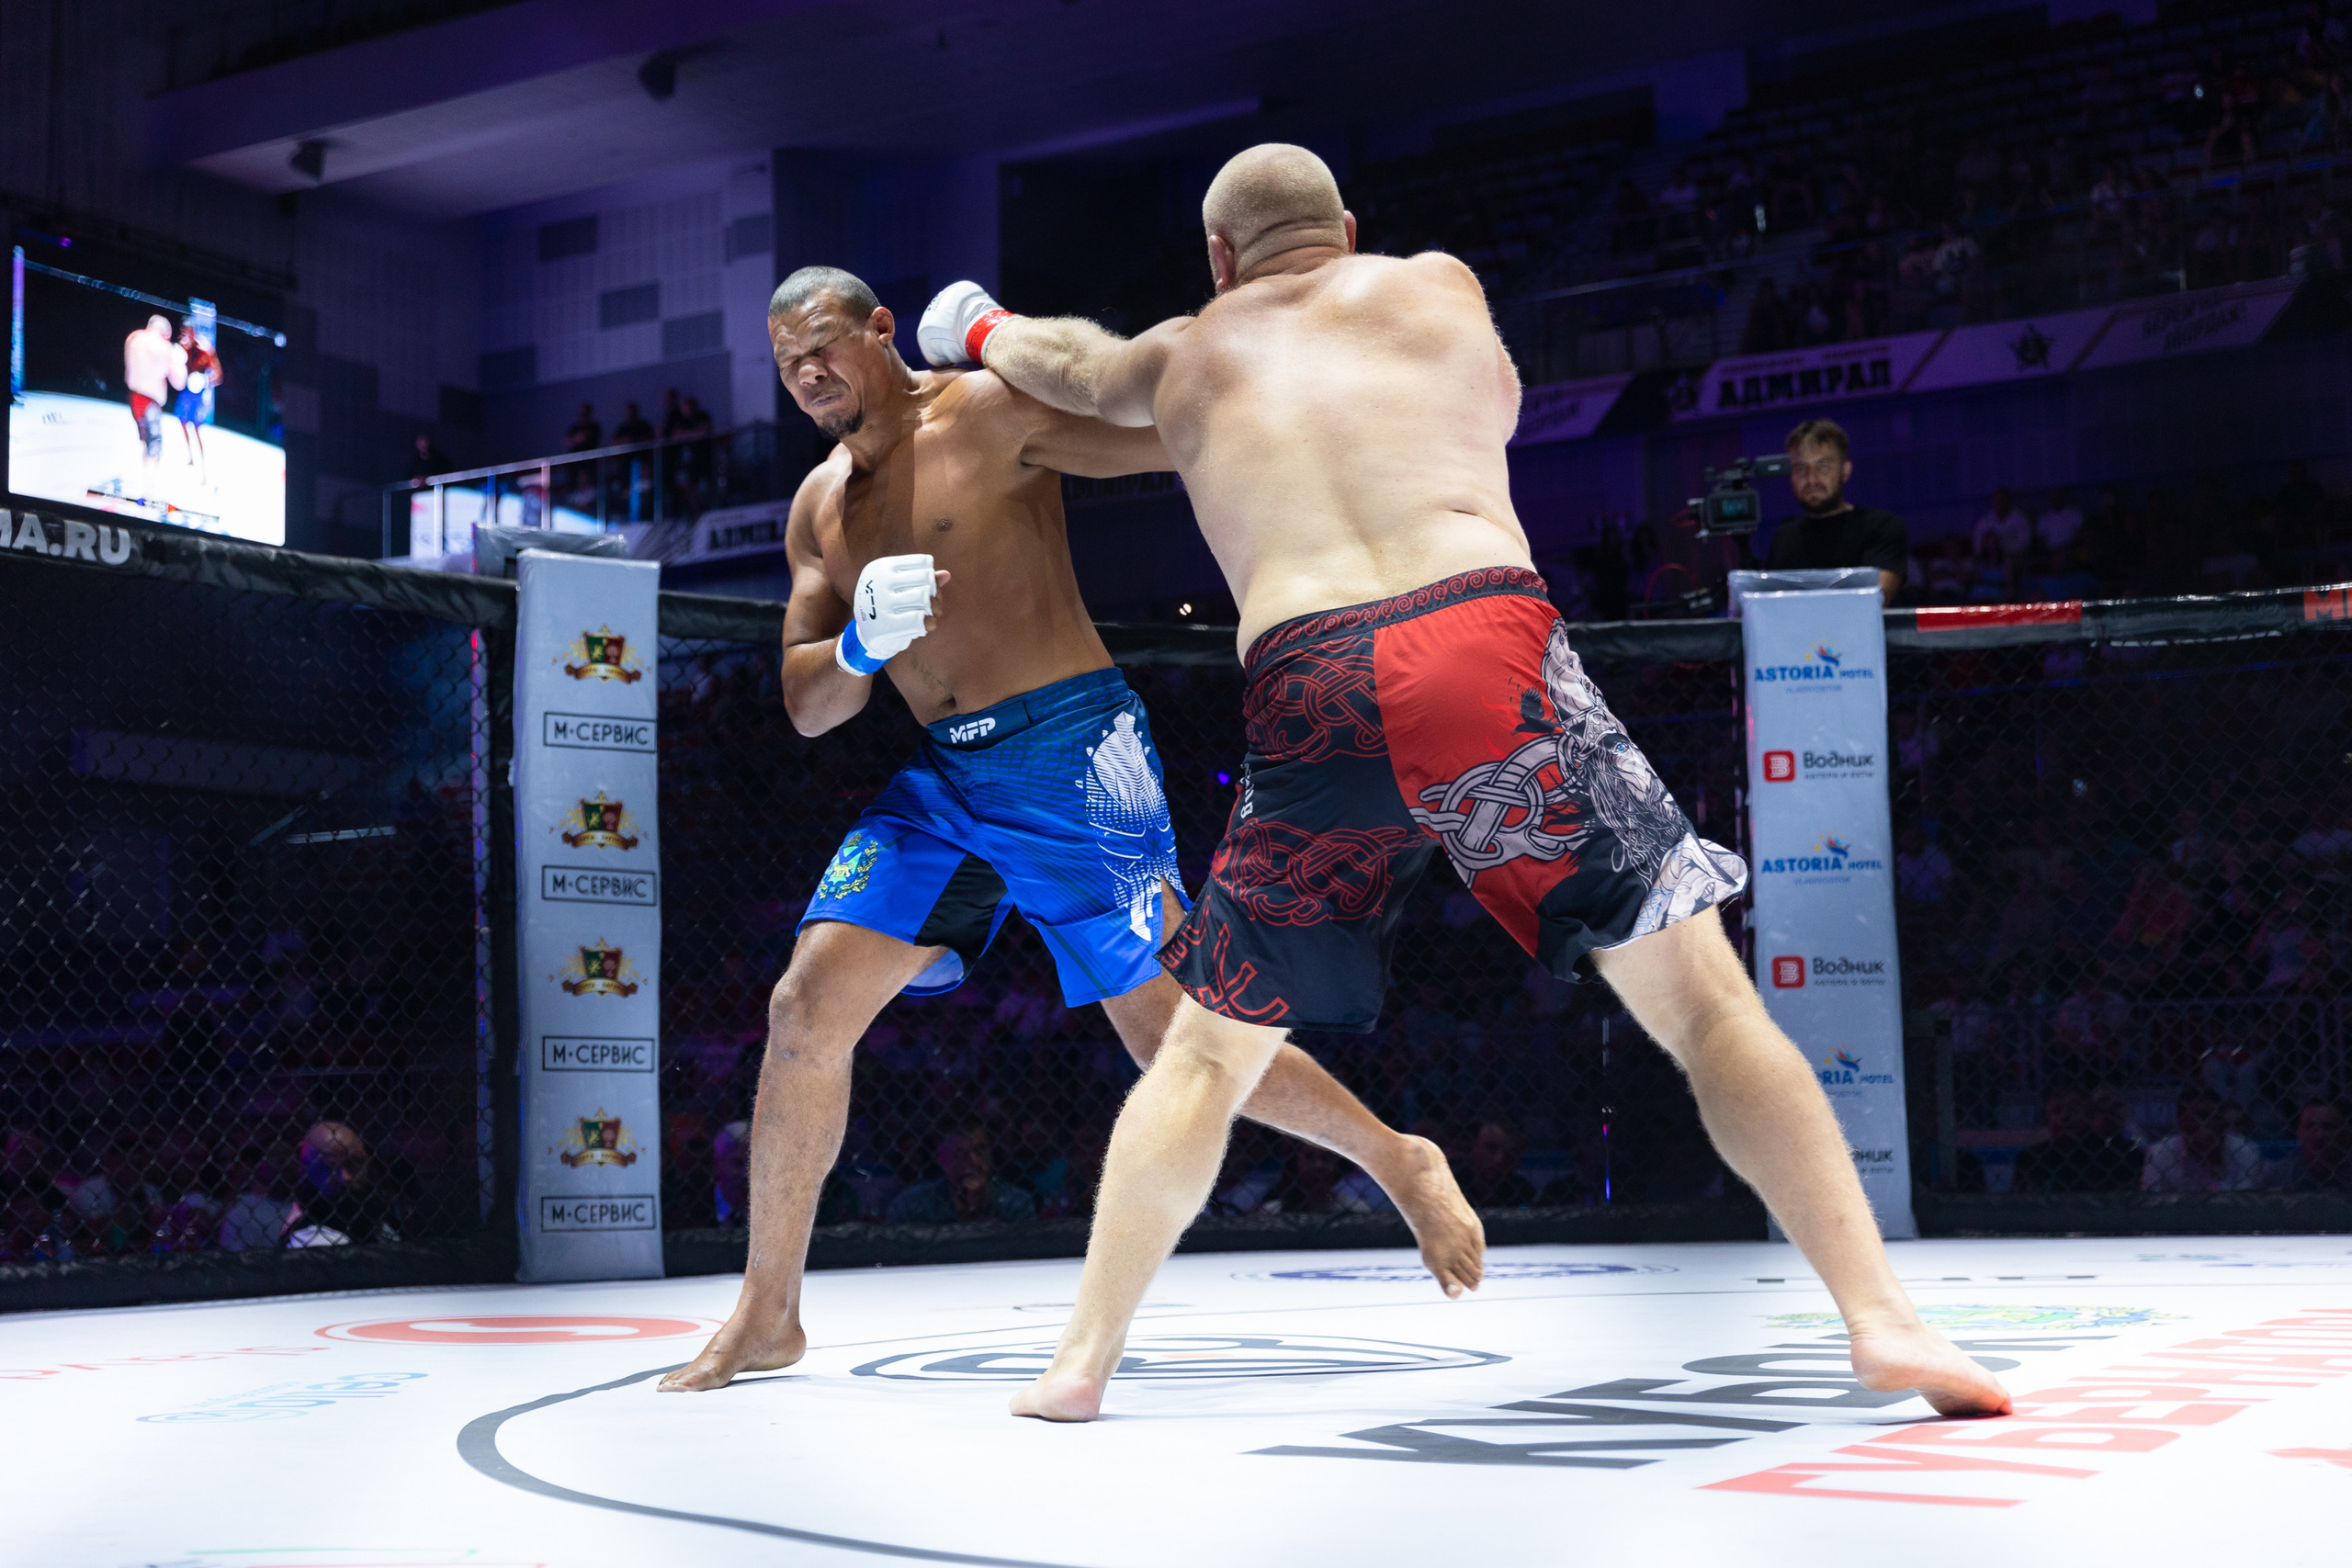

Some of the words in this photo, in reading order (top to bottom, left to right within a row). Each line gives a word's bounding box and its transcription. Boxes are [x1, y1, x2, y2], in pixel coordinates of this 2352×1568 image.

[1718, 358, 1891, 408] АДМИРАЛ
[2303, 589, 2352, 622] M
[1755, 664, 1834, 682] ASTORIA
[1839, 668, 1874, 680] HOTEL
[949, 717, 997, 745] MFP
[1804, 750, 1874, 769] Водник
[1761, 856, 1843, 874] ASTORIA
[1848, 859, 1883, 871] HOTEL
[1813, 956, 1884, 976] Водник
[1819, 1069, 1853, 1085] RIA
[1696, 1308, 2352, 1508] ГУБЕРНАТО
